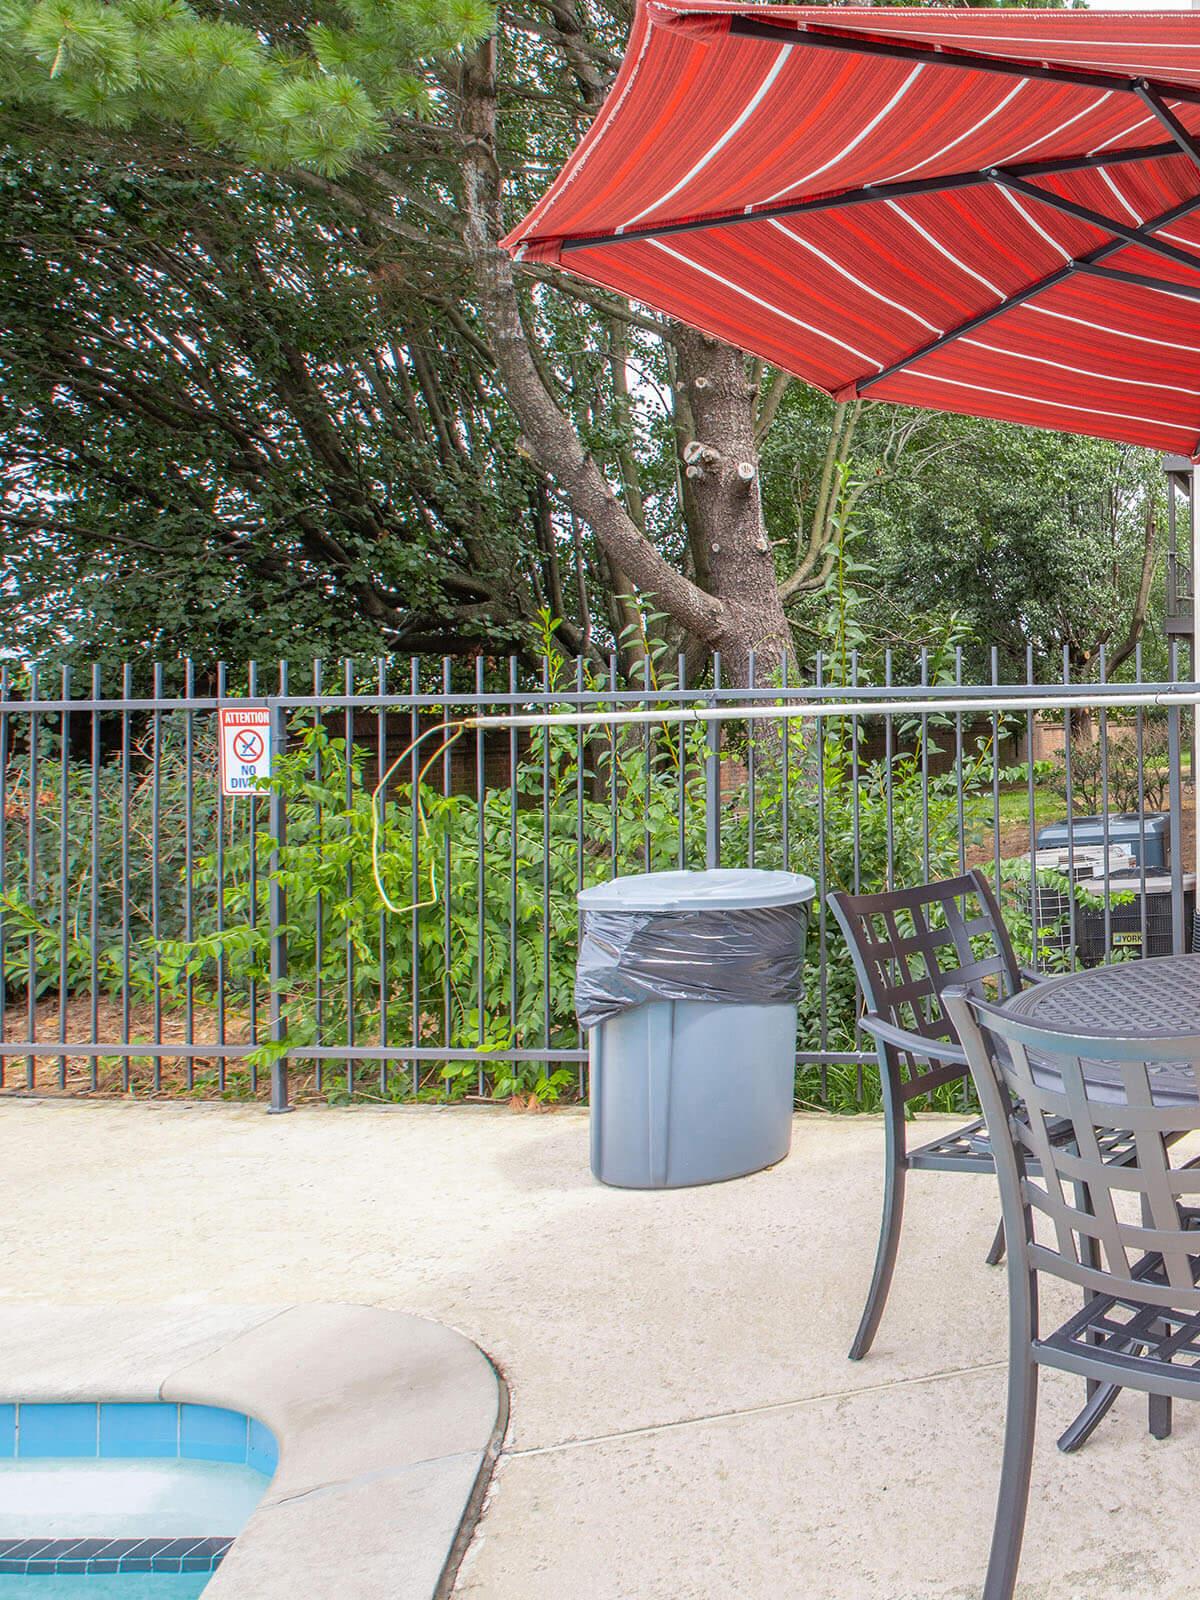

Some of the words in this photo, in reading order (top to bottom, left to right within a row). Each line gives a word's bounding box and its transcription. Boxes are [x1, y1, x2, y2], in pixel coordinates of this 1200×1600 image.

[225, 711, 270, 724] ATTENTION
[241, 765, 256, 775] NO
[231, 777, 257, 788] DIV
[1122, 935, 1143, 943] YORK
